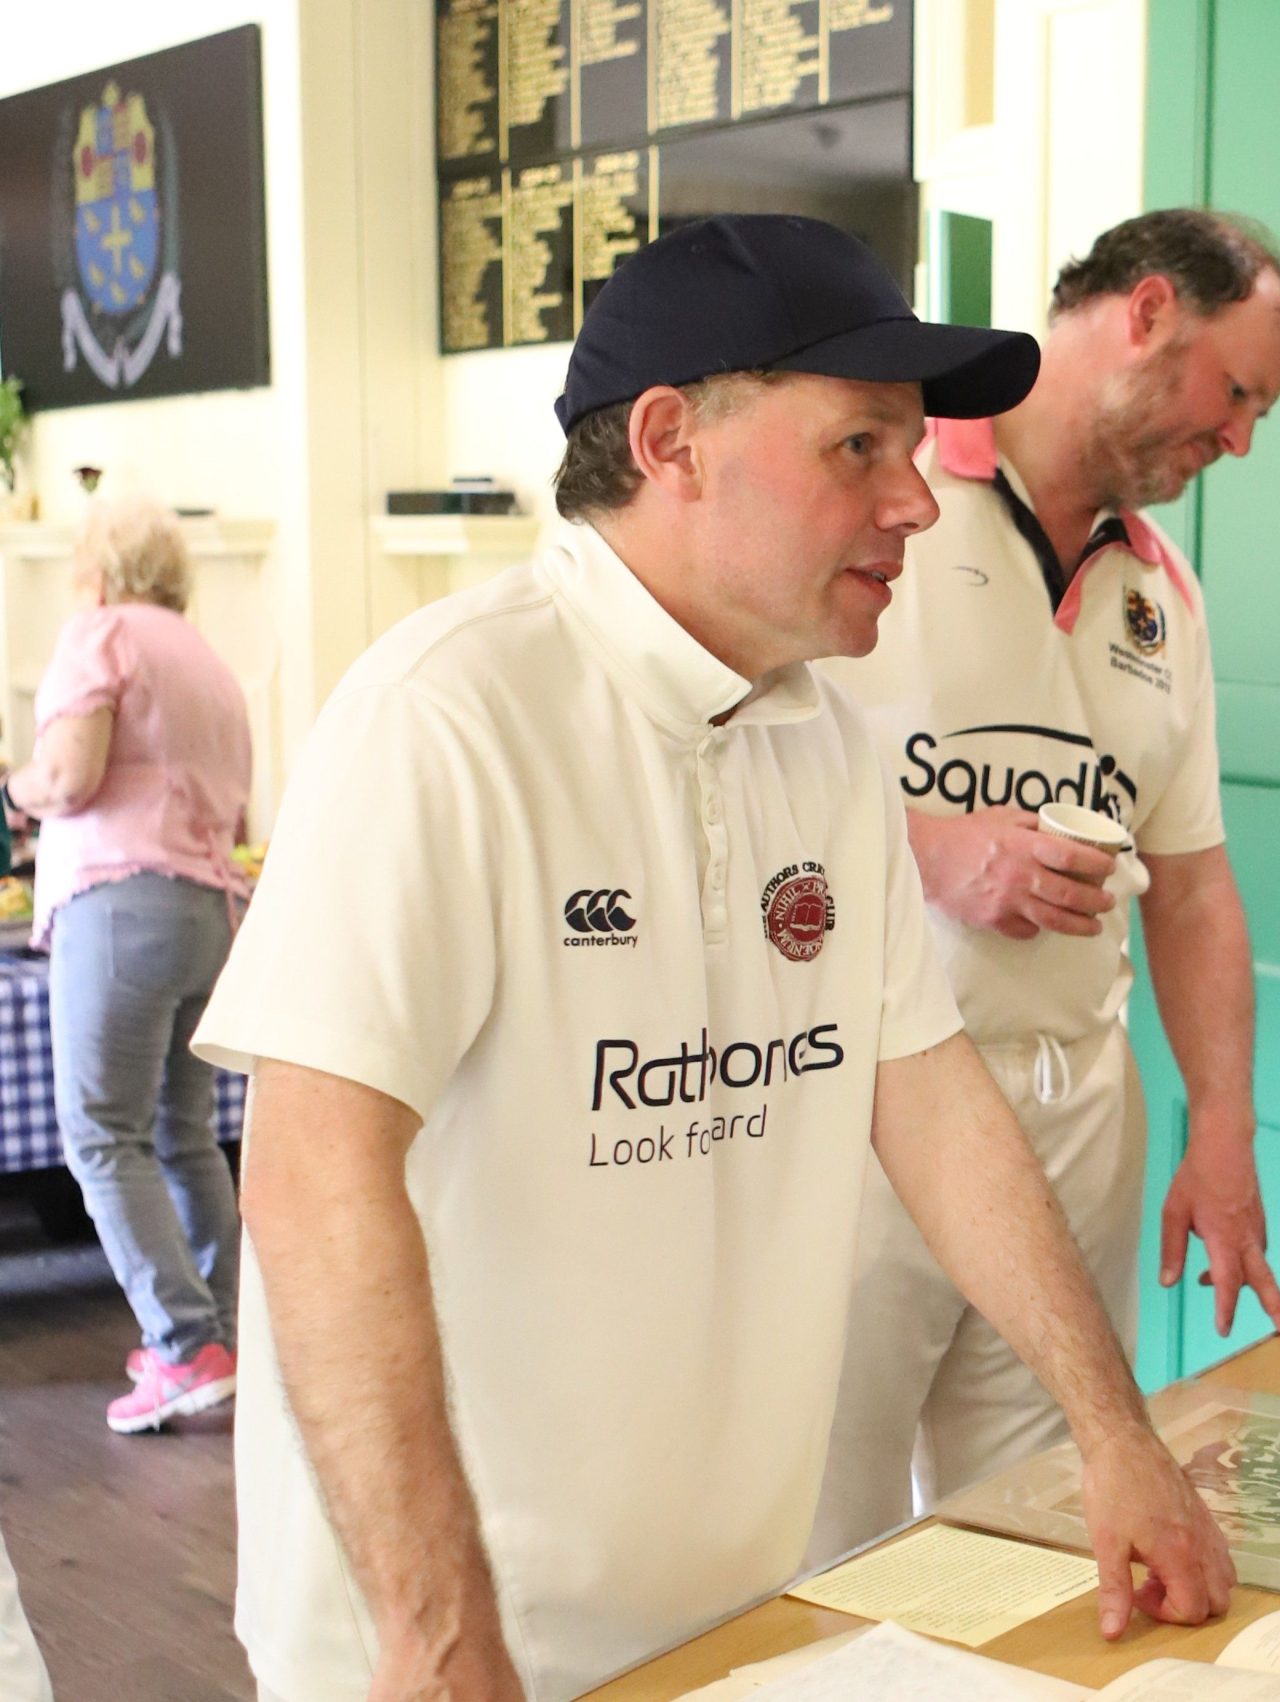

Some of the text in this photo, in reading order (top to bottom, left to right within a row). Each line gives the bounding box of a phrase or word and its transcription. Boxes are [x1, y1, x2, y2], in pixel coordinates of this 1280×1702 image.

[563, 933, 639, 948] canterbury
[589, 1104, 767, 1167] Look foard
